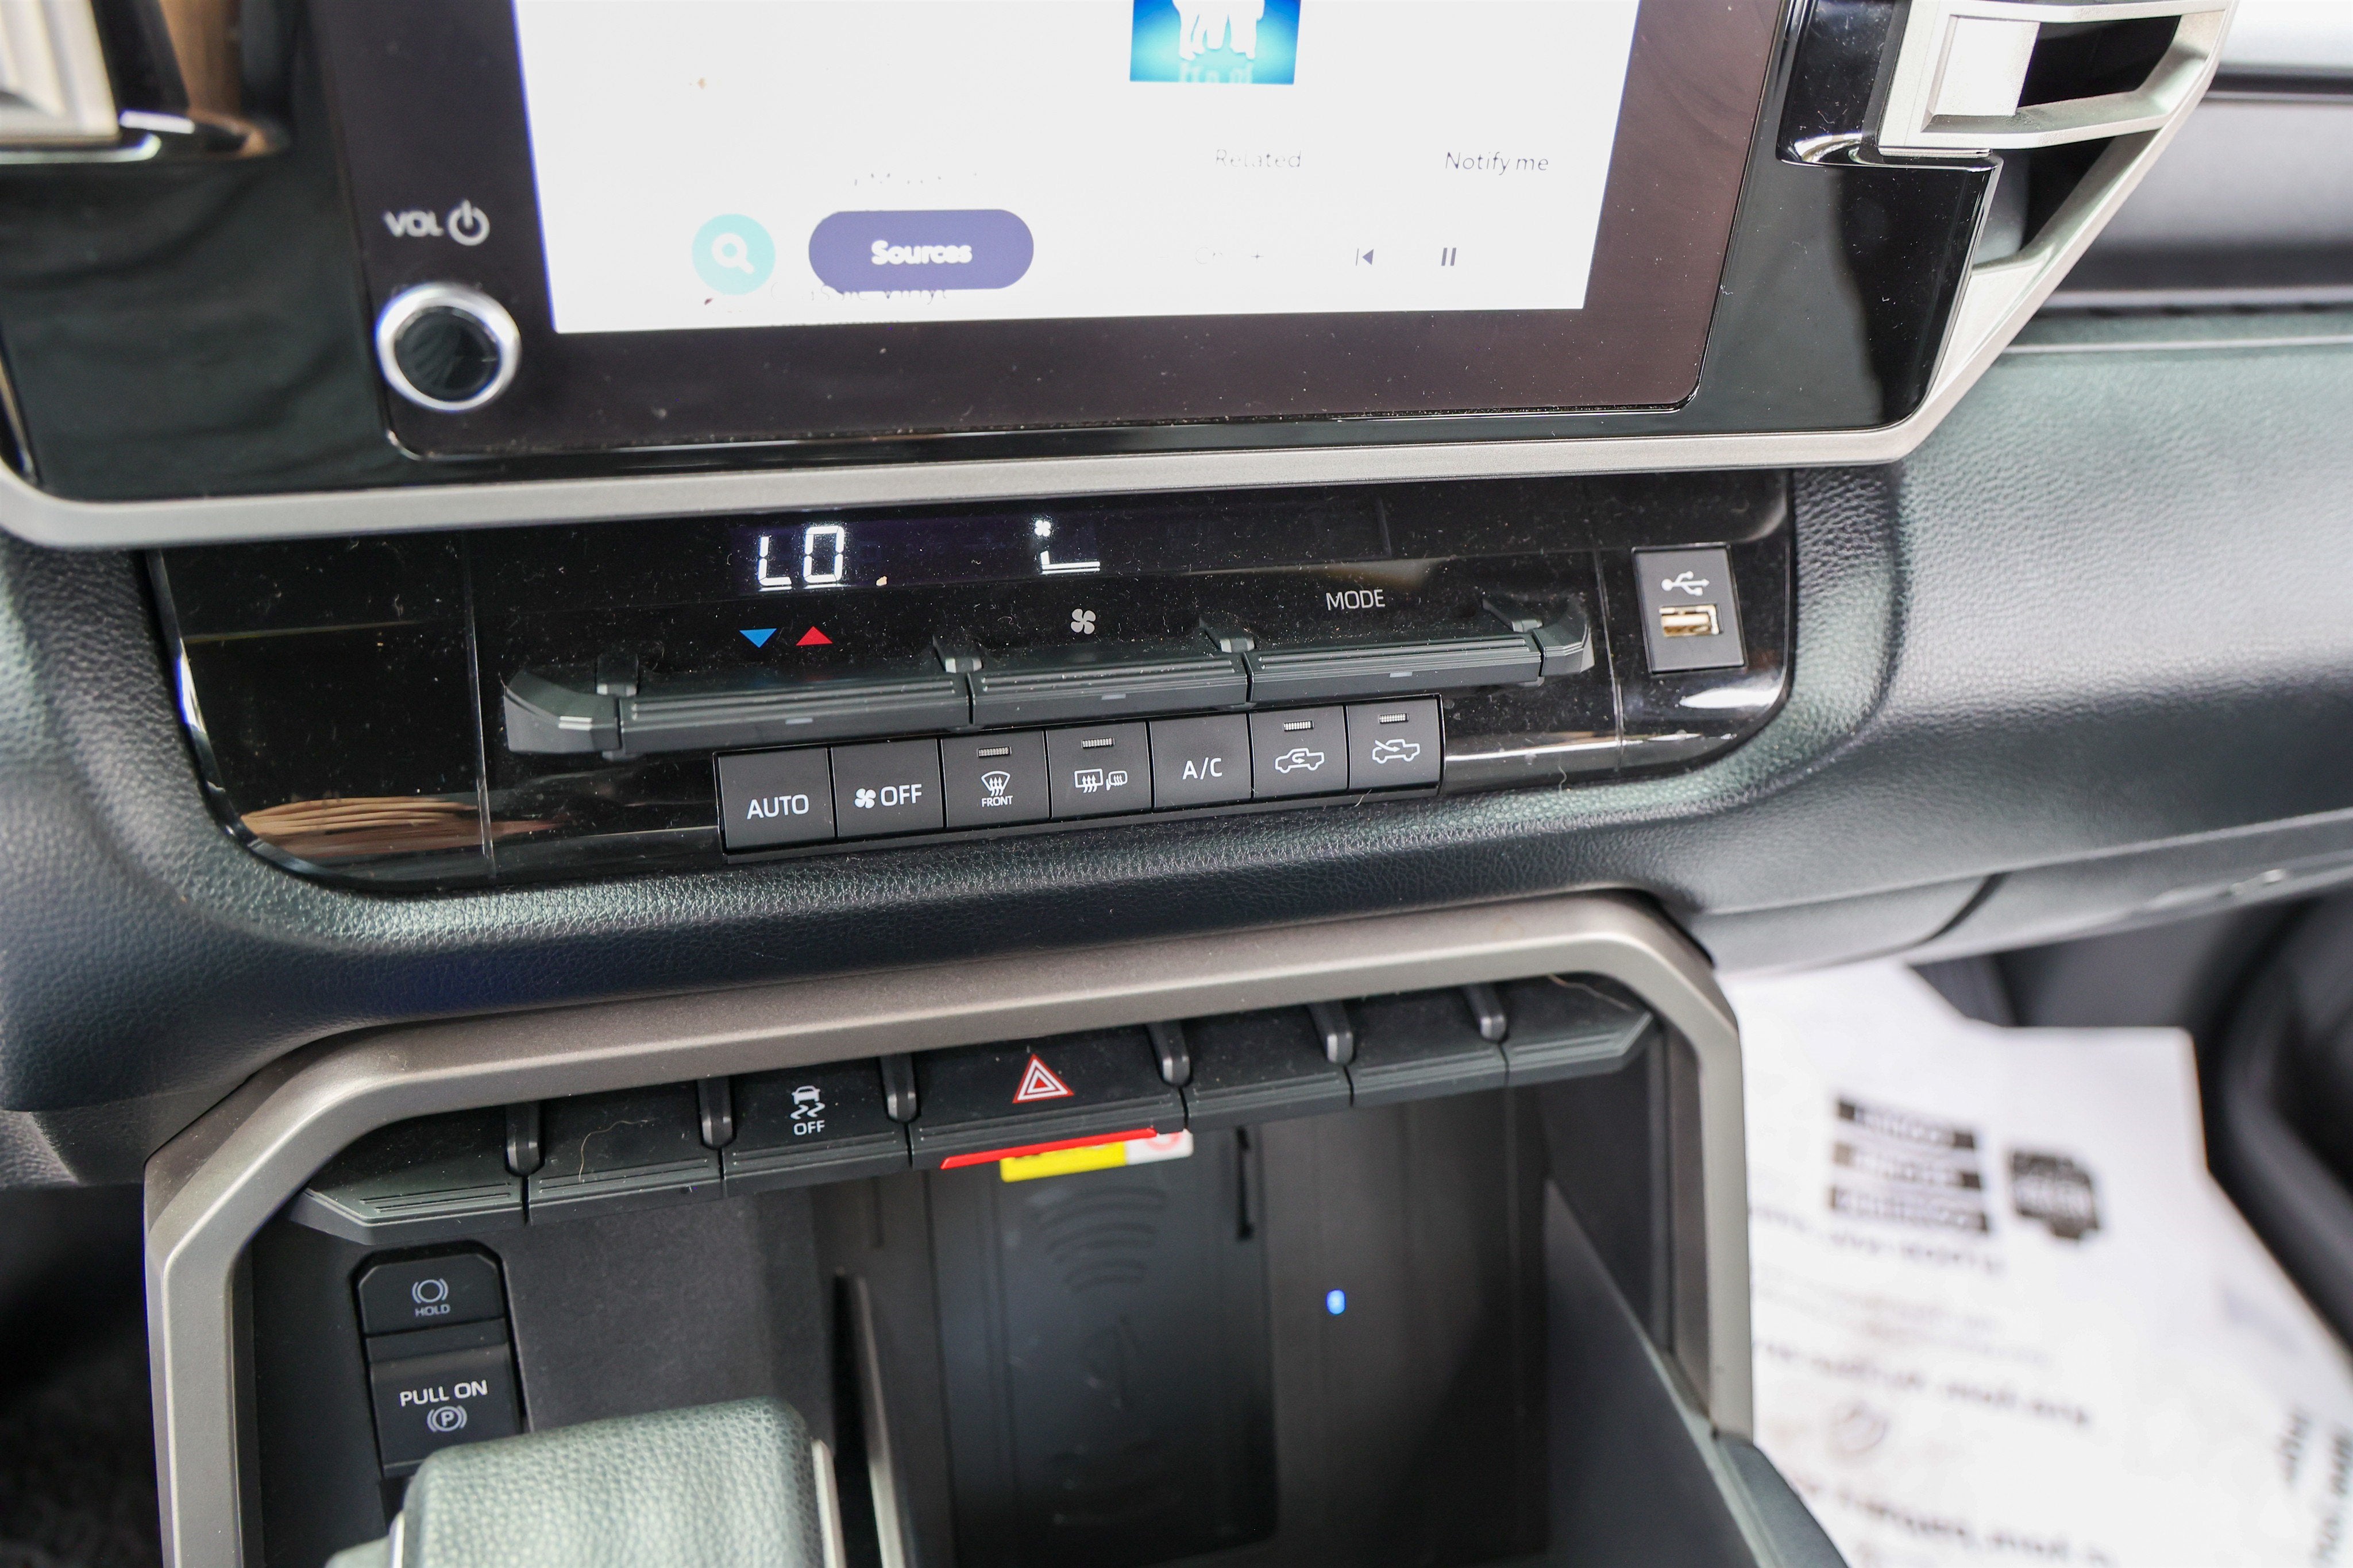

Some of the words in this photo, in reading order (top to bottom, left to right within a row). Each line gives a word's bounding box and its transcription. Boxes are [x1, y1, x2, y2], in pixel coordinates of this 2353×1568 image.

[1215, 149, 1302, 168] Related
[1445, 151, 1510, 176] Notify
[1516, 157, 1549, 171] me
[384, 210, 442, 237] VOL
[871, 240, 973, 265] Sources
[757, 524, 846, 587] LO
[1326, 589, 1386, 611] MODE
[1182, 757, 1222, 780] A/C
[880, 783, 923, 806] OFF
[981, 795, 1013, 807] FRONT
[747, 794, 809, 820] AUTO
[793, 1119, 826, 1136] OFF
[414, 1303, 450, 1316] HOLD
[400, 1386, 450, 1407] PULL
[454, 1380, 488, 1399] ON
